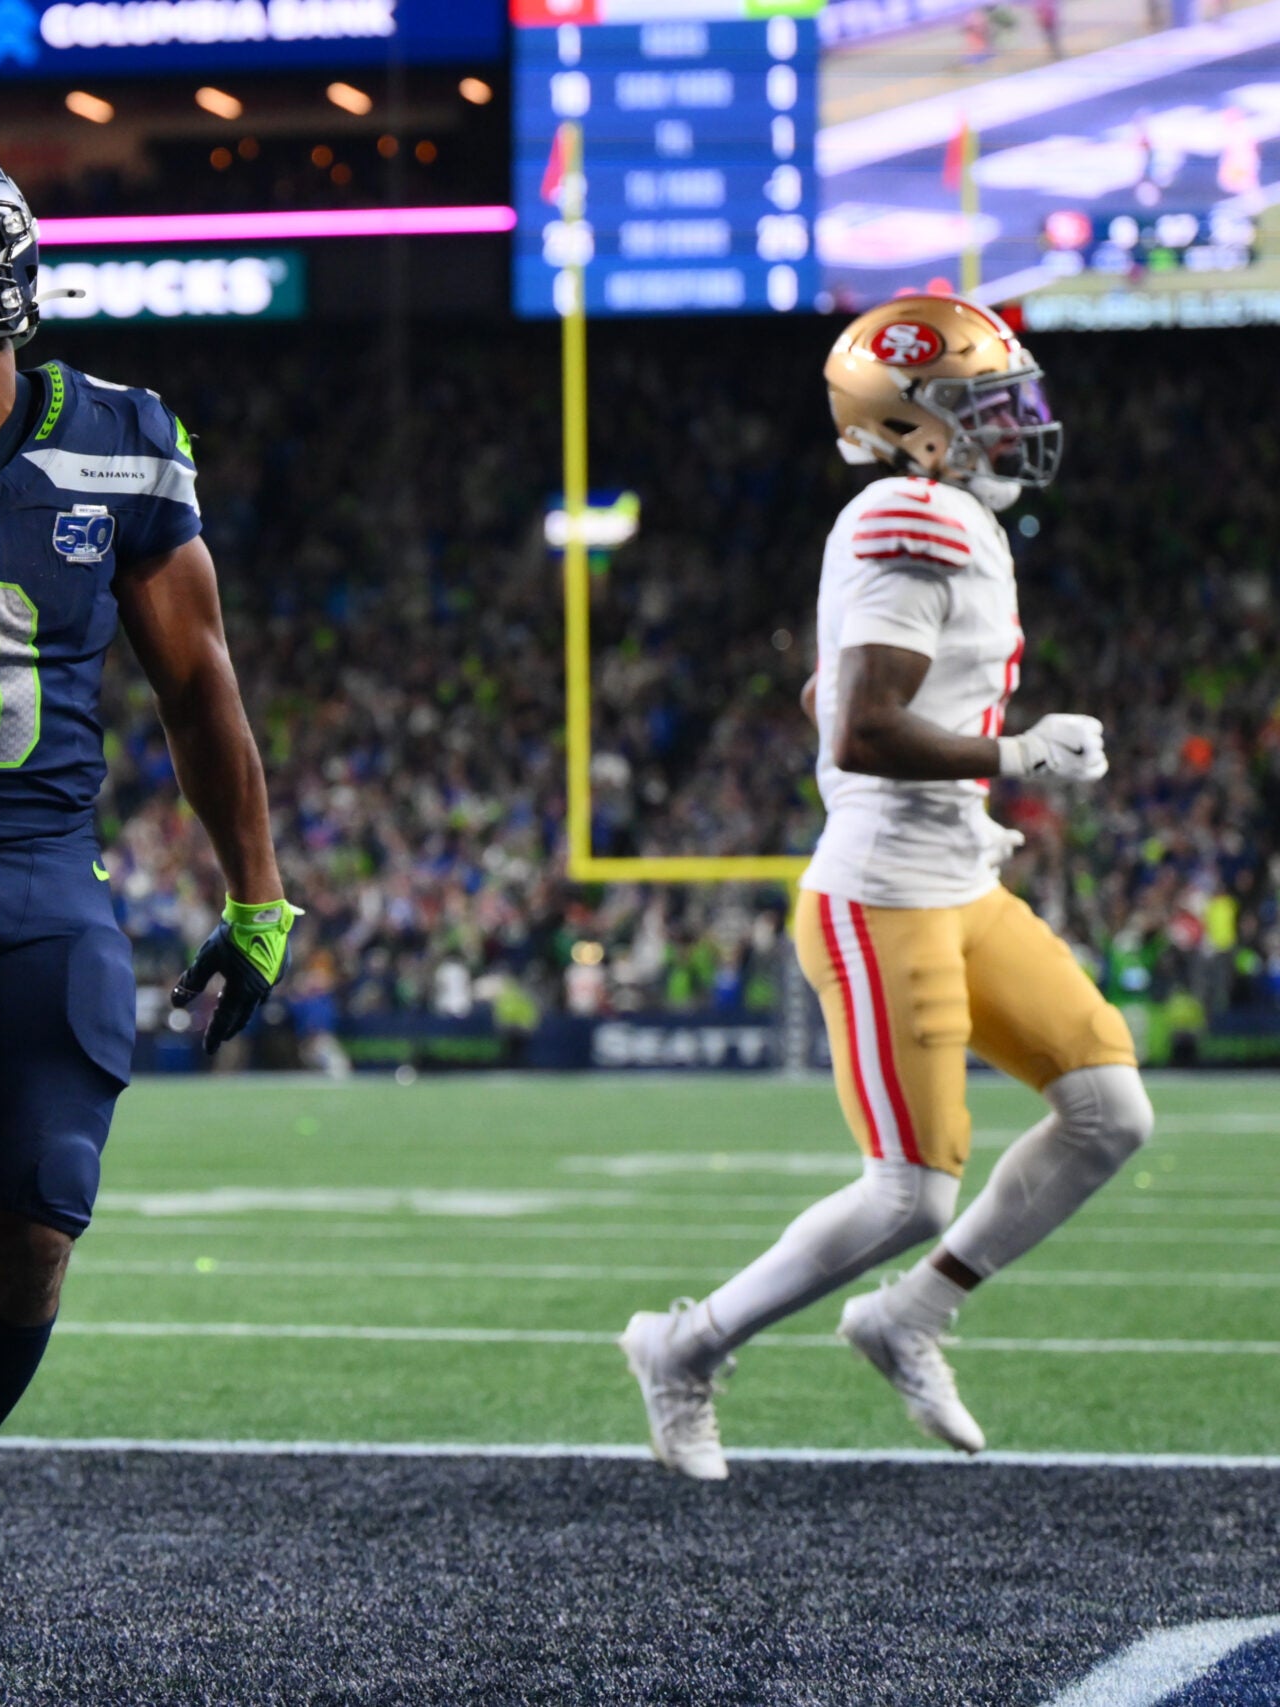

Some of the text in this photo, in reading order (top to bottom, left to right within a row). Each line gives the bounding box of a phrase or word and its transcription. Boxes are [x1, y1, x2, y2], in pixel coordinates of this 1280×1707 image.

[80, 468, 146, 480] SEAHAWKS
[52, 512, 116, 555] 50
[592, 1022, 832, 1066] SEATT
